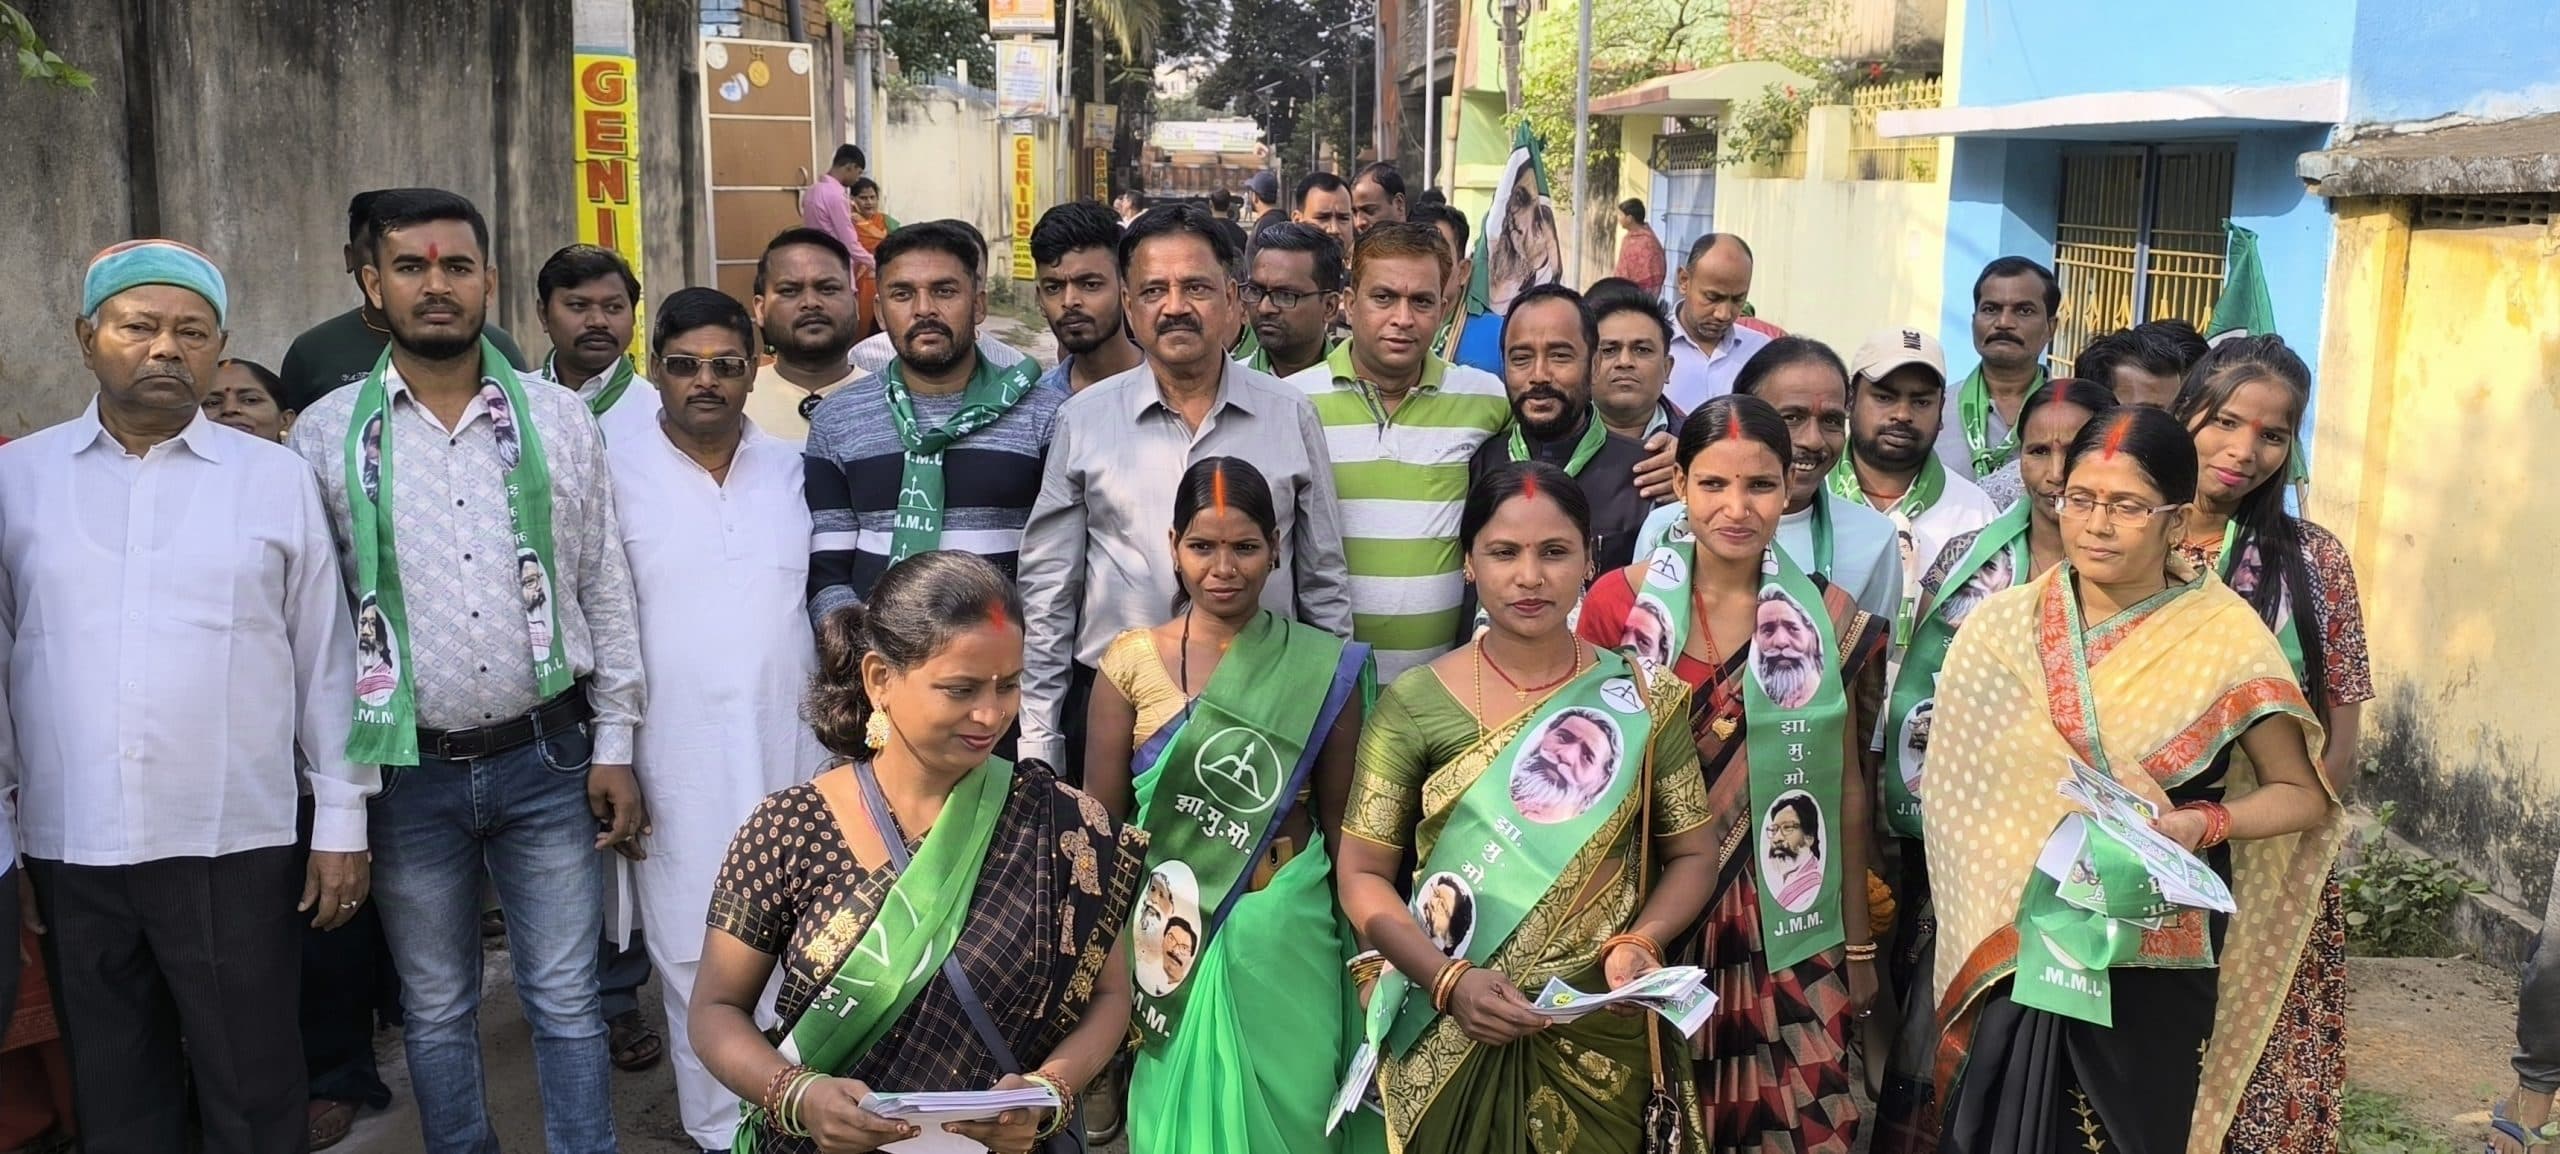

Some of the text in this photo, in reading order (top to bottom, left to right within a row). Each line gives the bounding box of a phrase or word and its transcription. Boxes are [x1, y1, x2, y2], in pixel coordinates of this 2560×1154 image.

[581, 61, 629, 250] GENI
[1016, 138, 1031, 237] GENIUS
[1783, 767, 1809, 785] मो.
[1774, 911, 1823, 937] J.M.M.
